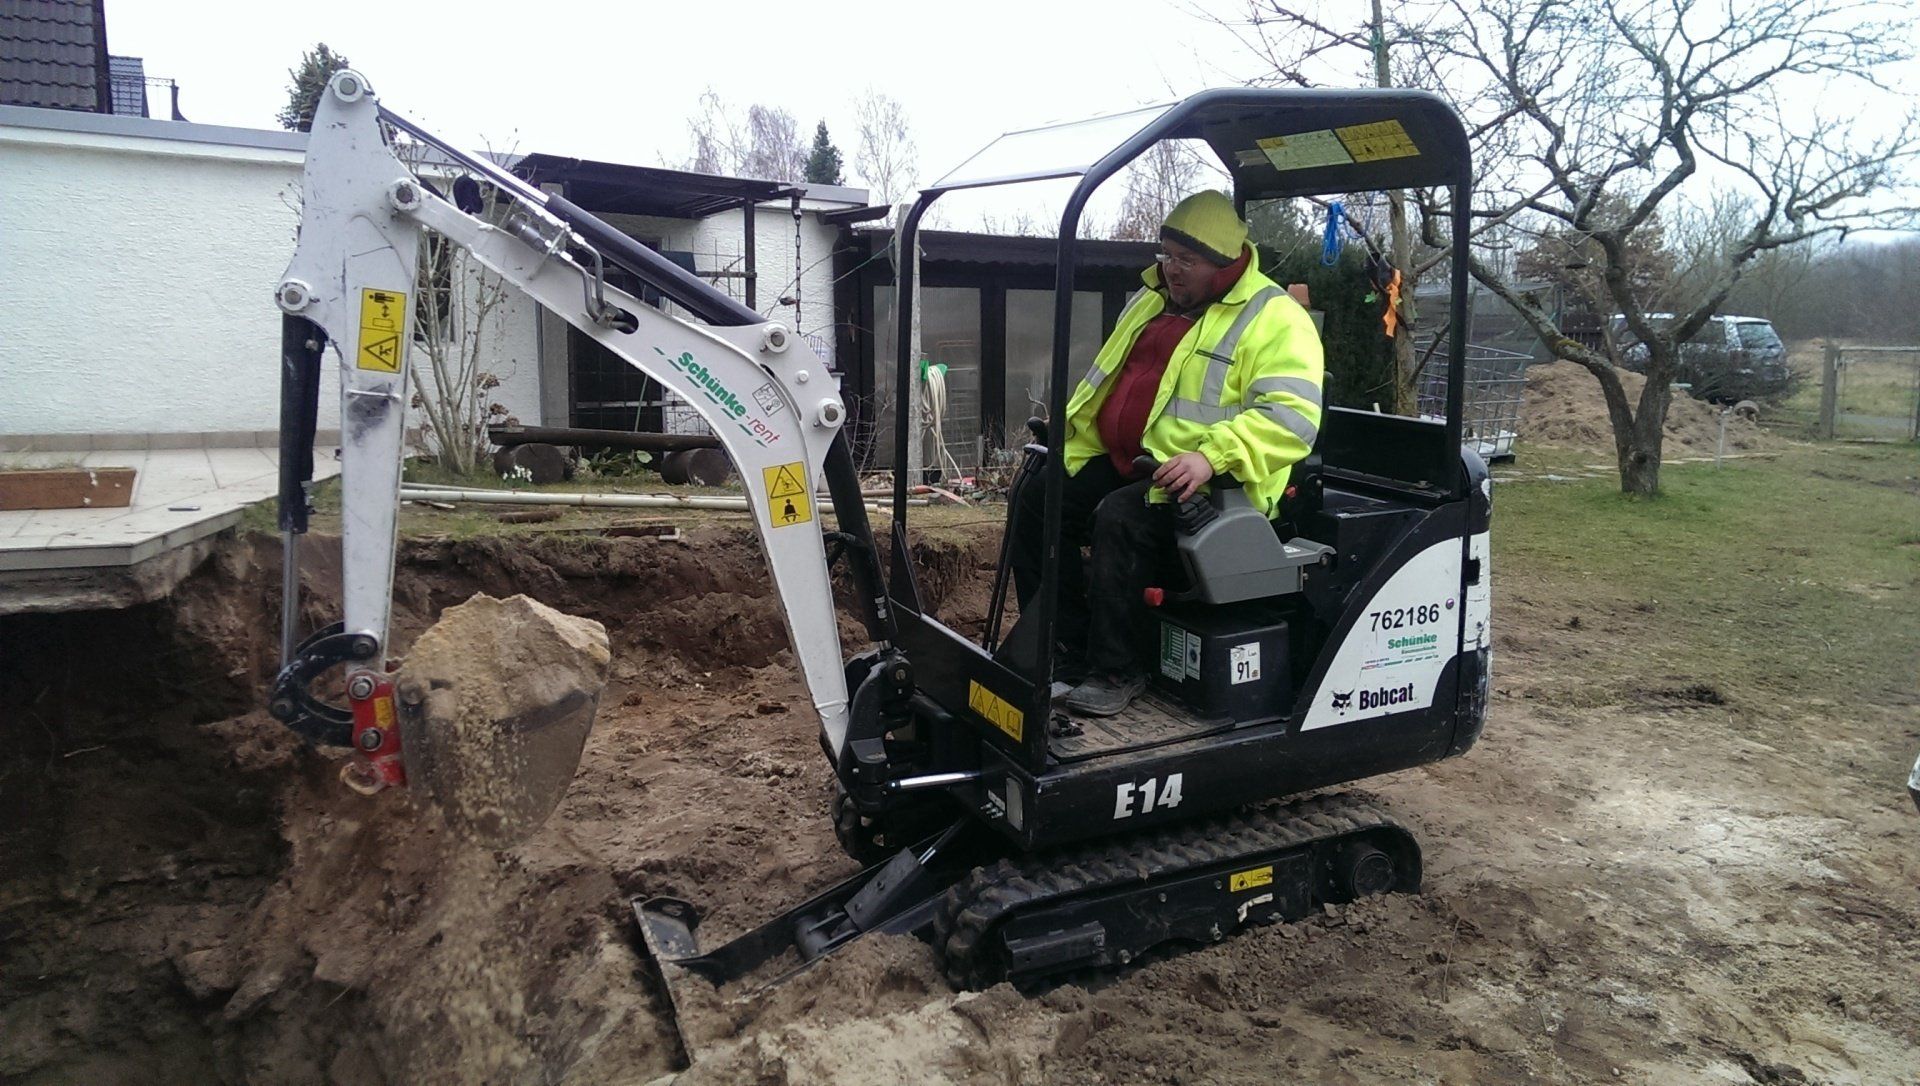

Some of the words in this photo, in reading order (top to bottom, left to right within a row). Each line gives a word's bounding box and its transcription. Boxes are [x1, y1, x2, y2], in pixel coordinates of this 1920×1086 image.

[1370, 603, 1440, 632] 762186
[1388, 633, 1438, 649] Schünke
[1237, 660, 1250, 681] 91
[1359, 682, 1414, 711] Bobcat
[1113, 772, 1184, 820] E14
